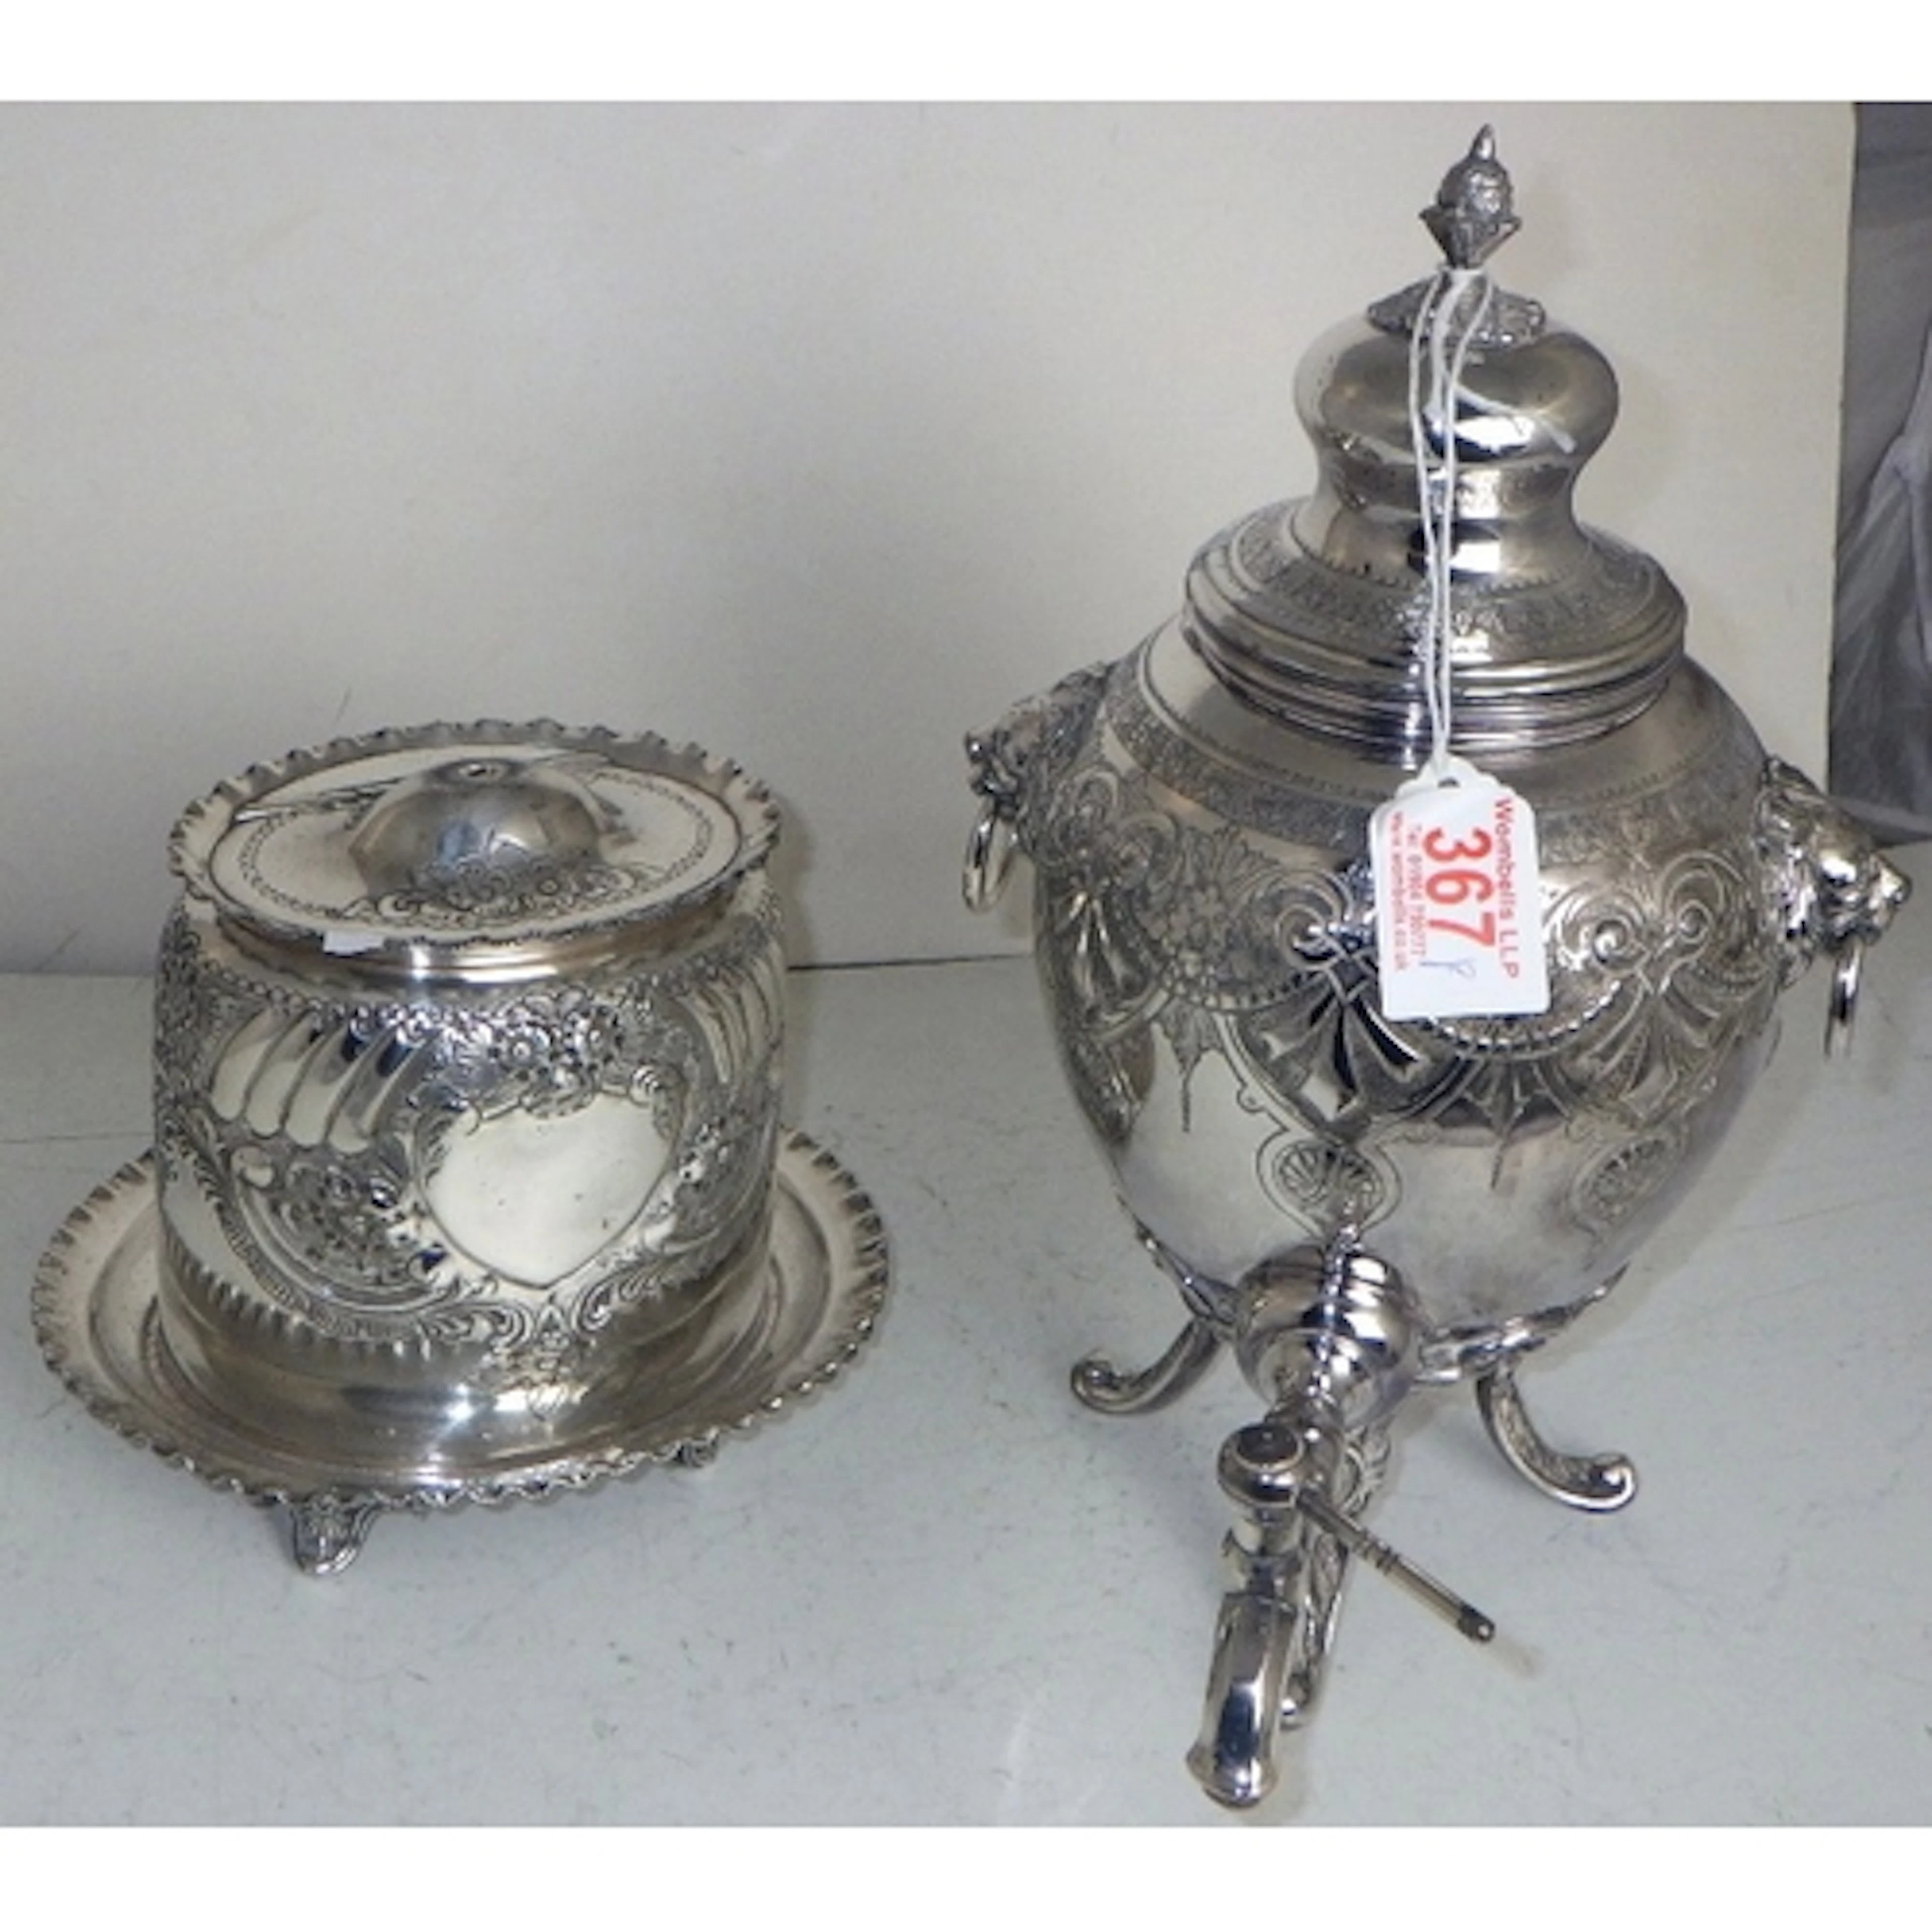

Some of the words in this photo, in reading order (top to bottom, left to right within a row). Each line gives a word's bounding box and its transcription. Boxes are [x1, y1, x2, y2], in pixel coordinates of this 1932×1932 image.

[1423, 827, 1495, 946] 367
[1495, 798, 1515, 920] Wombells
[1500, 930, 1519, 978] LLP
